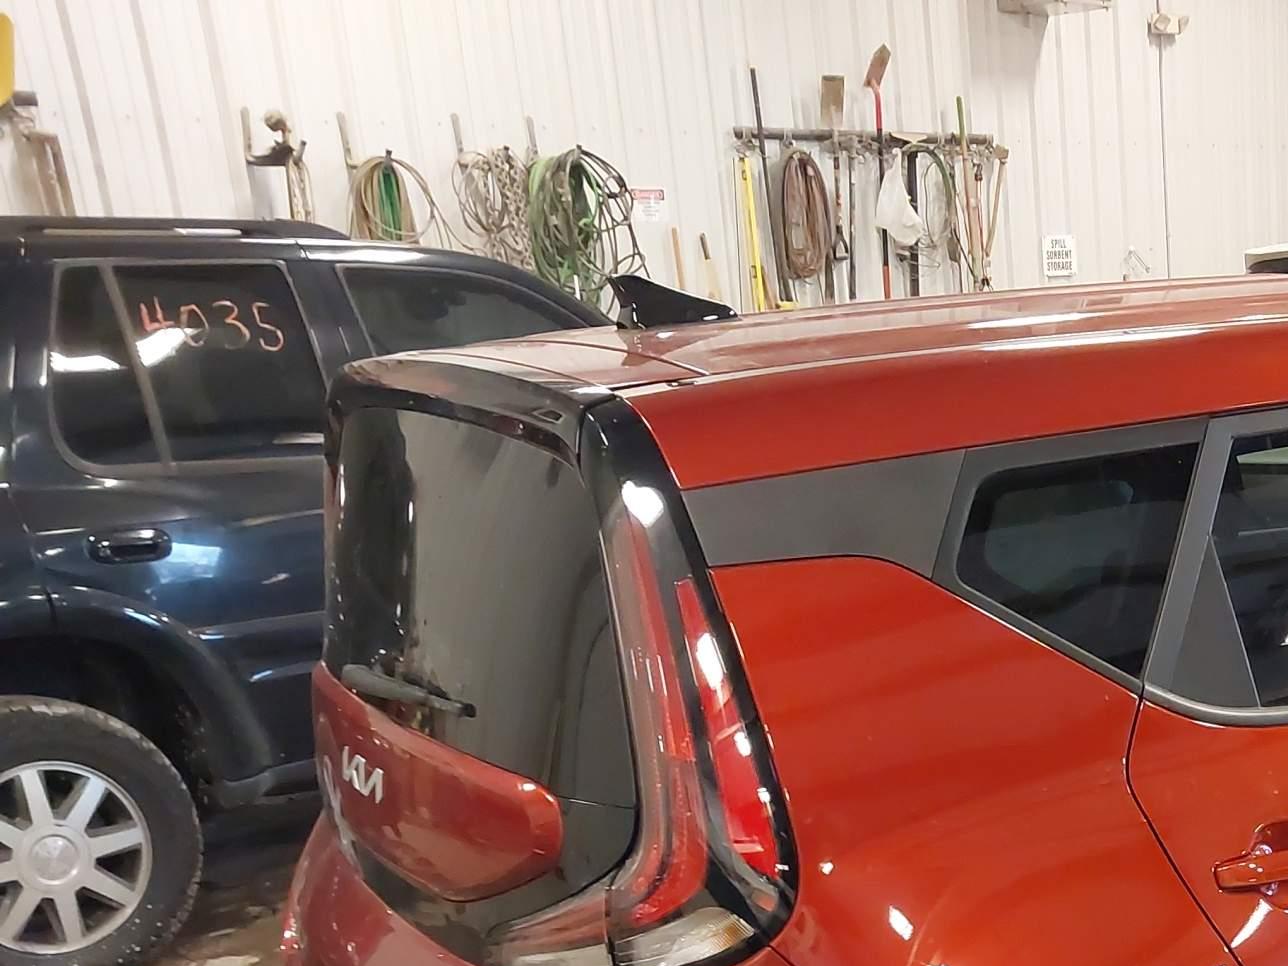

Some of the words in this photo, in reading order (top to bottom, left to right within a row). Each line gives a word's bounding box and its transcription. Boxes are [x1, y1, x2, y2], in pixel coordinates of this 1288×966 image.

[1050, 239, 1067, 249] SPILL
[1046, 249, 1072, 260] SORBENT
[1047, 260, 1073, 271] STORAGE
[139, 296, 284, 351] 4035
[341, 745, 384, 804] KIA
